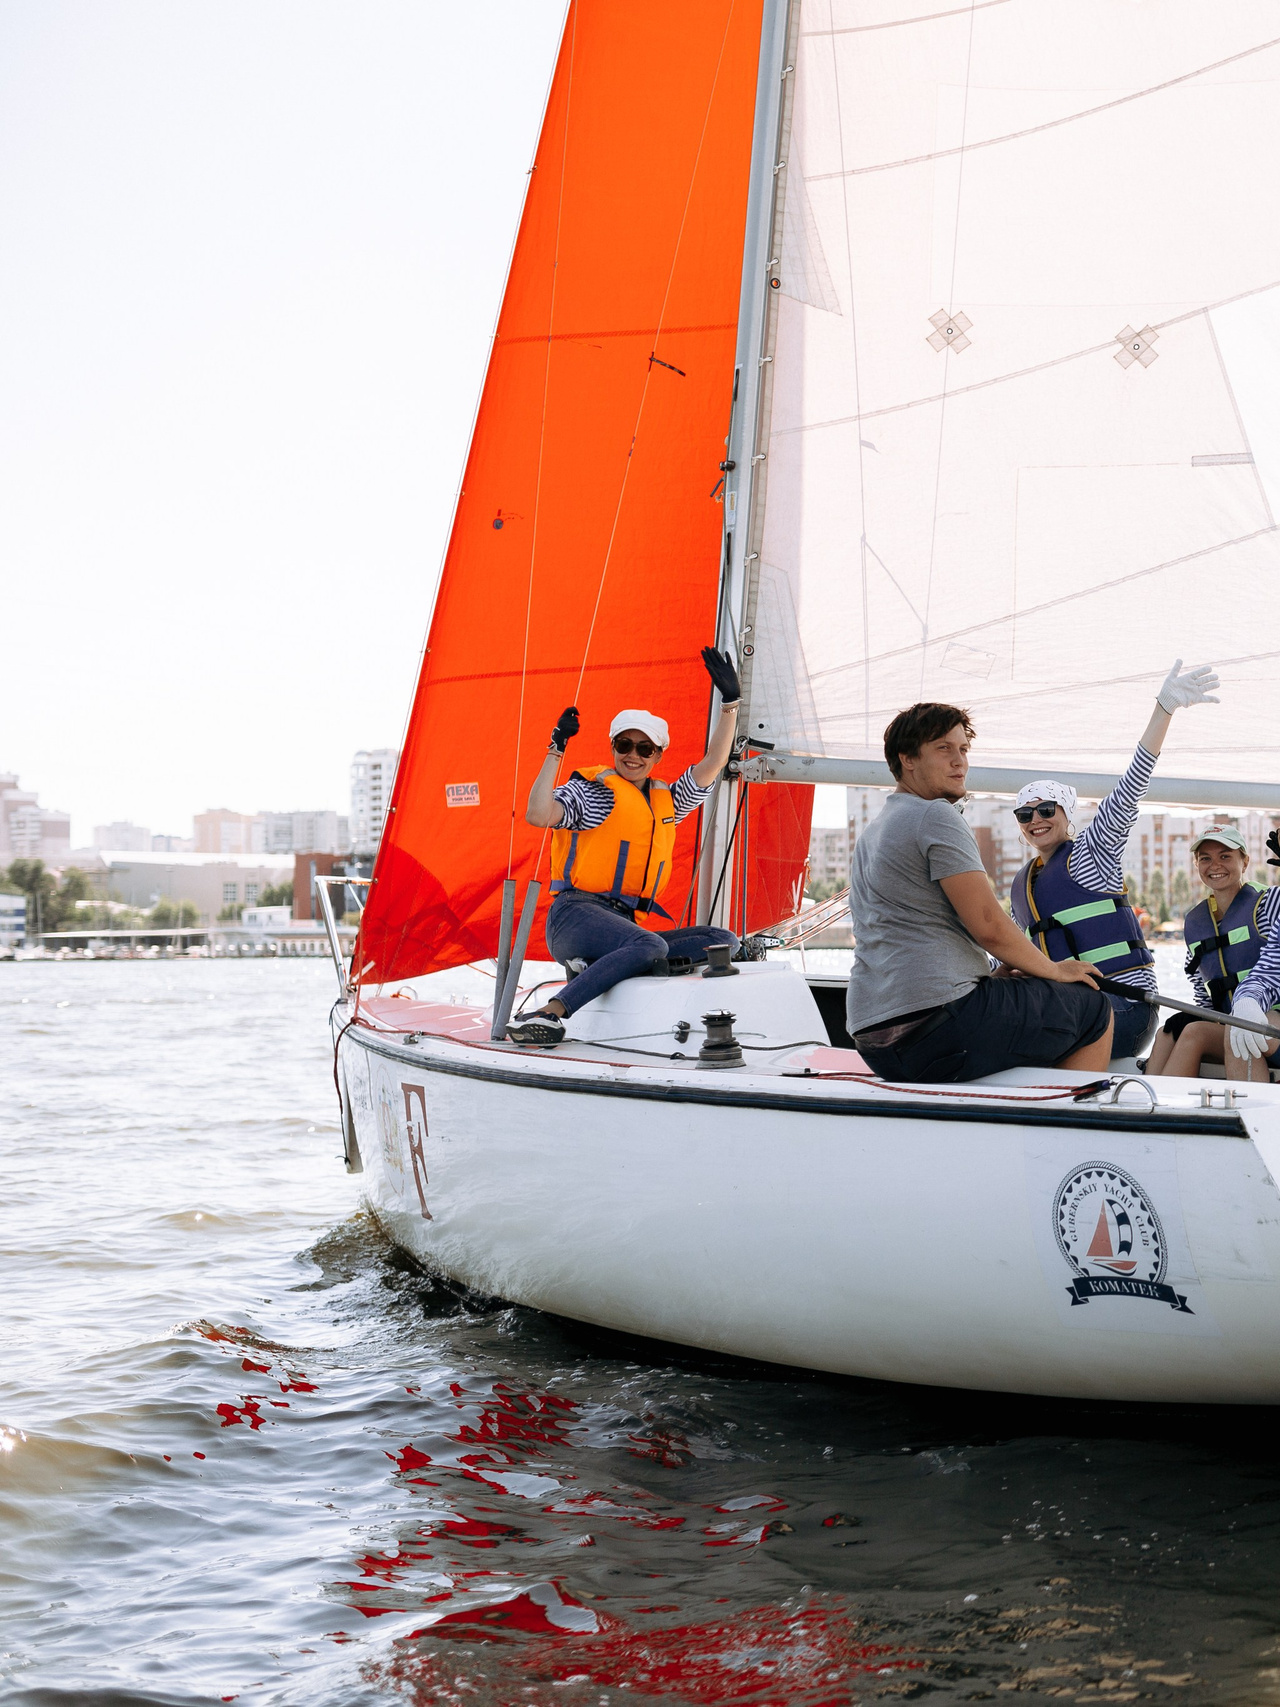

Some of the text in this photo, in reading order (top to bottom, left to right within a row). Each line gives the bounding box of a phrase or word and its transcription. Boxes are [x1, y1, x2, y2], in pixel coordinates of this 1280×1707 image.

[1068, 1182, 1150, 1247] GUBERNSKIY YACHT CLUB
[1088, 1280, 1160, 1298] KOMATEK
